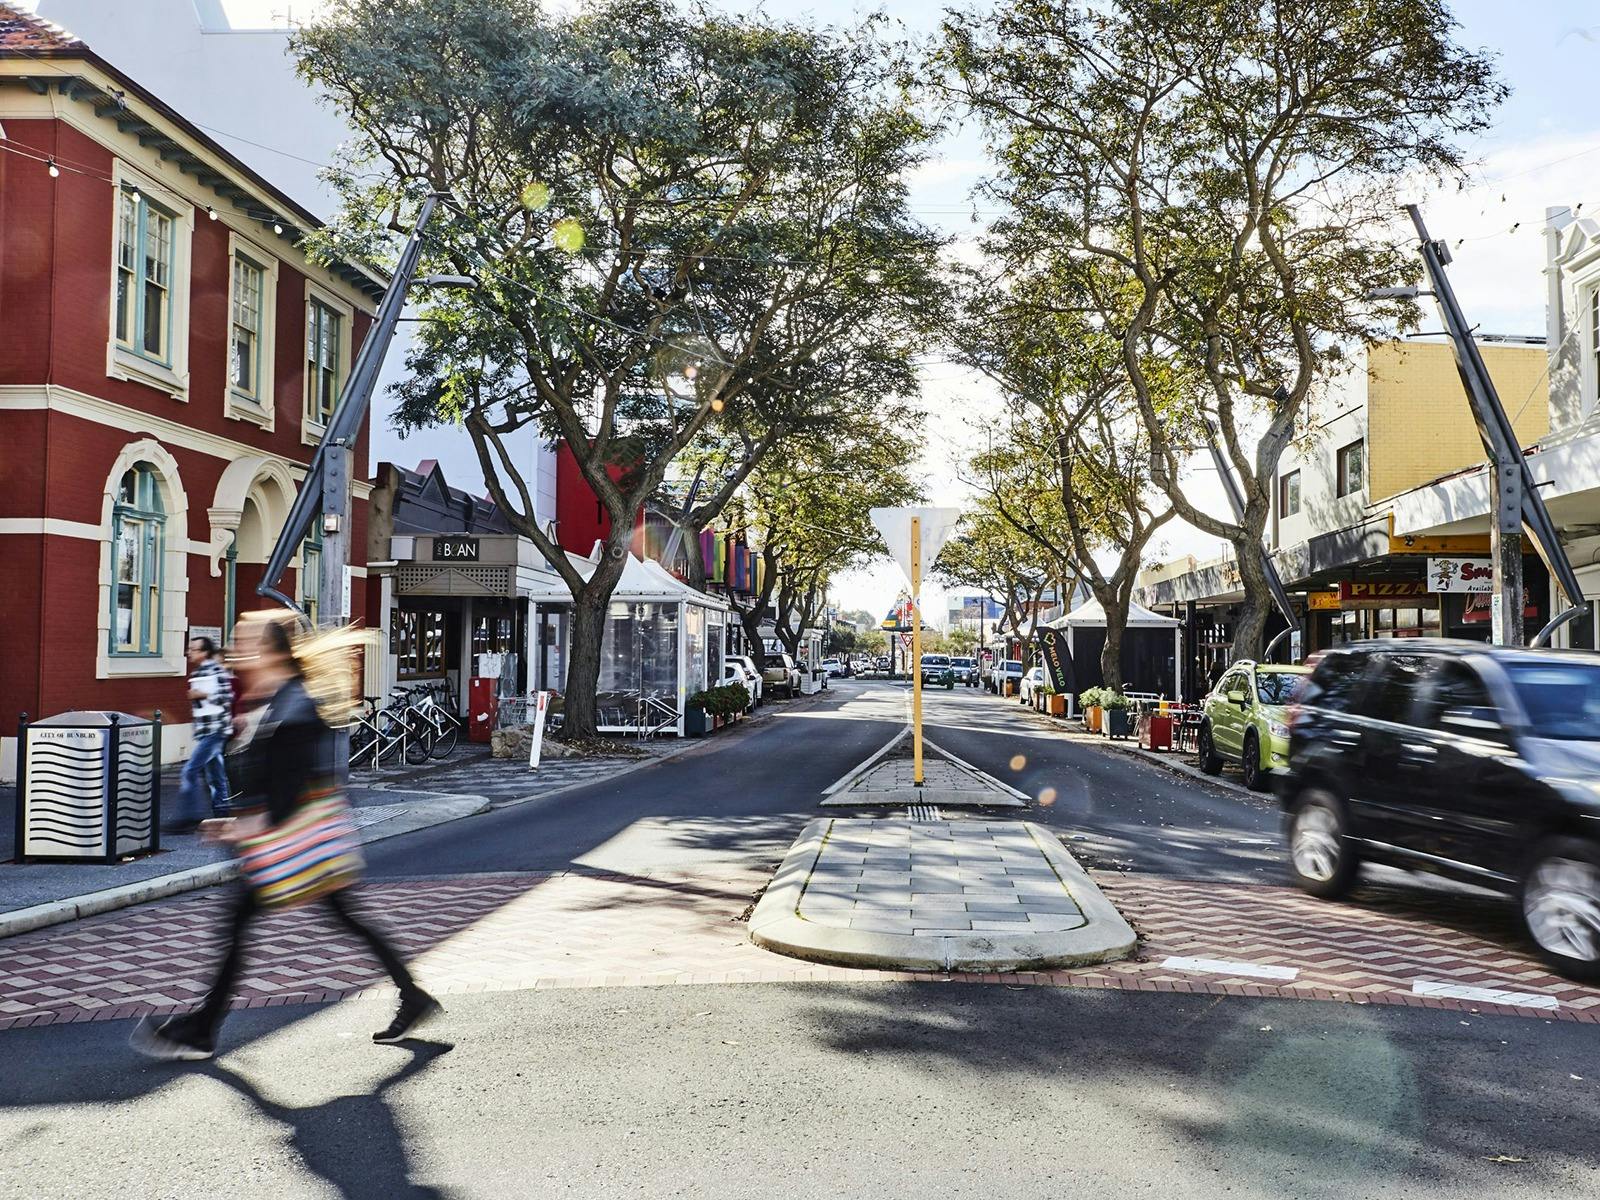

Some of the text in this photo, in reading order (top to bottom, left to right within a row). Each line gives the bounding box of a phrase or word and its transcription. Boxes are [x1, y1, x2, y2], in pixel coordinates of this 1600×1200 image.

[1351, 583, 1427, 596] PIZZA
[1048, 646, 1066, 686] MELO VELO
